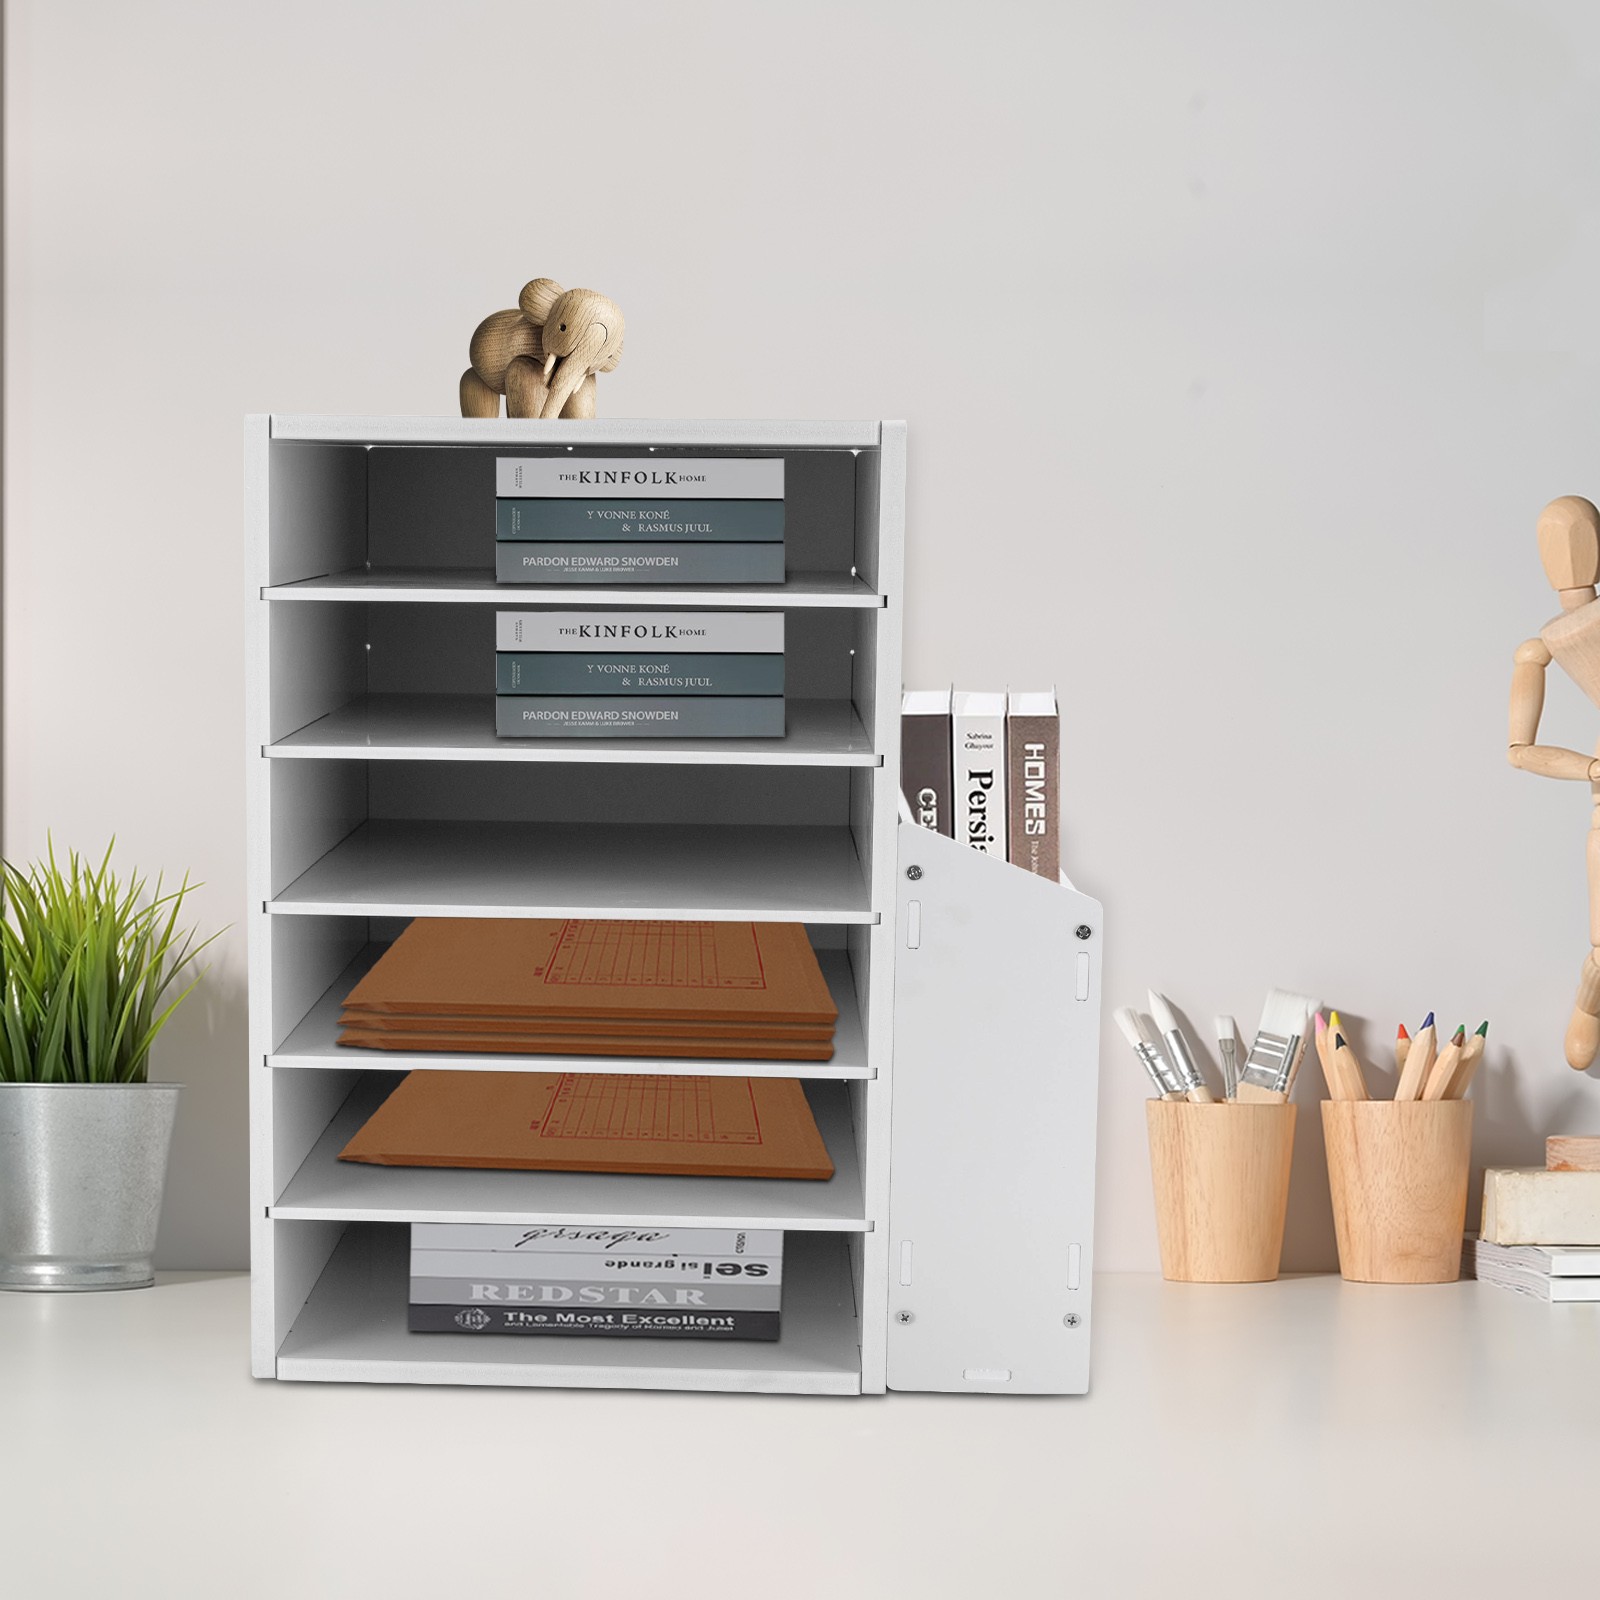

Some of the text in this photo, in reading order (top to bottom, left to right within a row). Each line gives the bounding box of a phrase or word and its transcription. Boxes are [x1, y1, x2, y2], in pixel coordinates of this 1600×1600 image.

[579, 471, 677, 484] KINFOLK
[639, 509, 670, 520] KONÉ
[622, 523, 712, 533] & RASMUS JUUL
[522, 557, 679, 566] PARDON EDWARD SNOWDEN
[579, 625, 677, 638] KINFOLK
[639, 663, 670, 674] KONÉ
[622, 677, 712, 687] & RASMUS JUUL
[522, 711, 679, 720] PARDON EDWARD SNOWDEN
[1024, 743, 1045, 835] HOMES
[605, 1260, 675, 1270] grande
[703, 1262, 769, 1279] sei
[469, 1283, 707, 1305] REDSTAR
[504, 1312, 735, 1326] The Most Excellent
